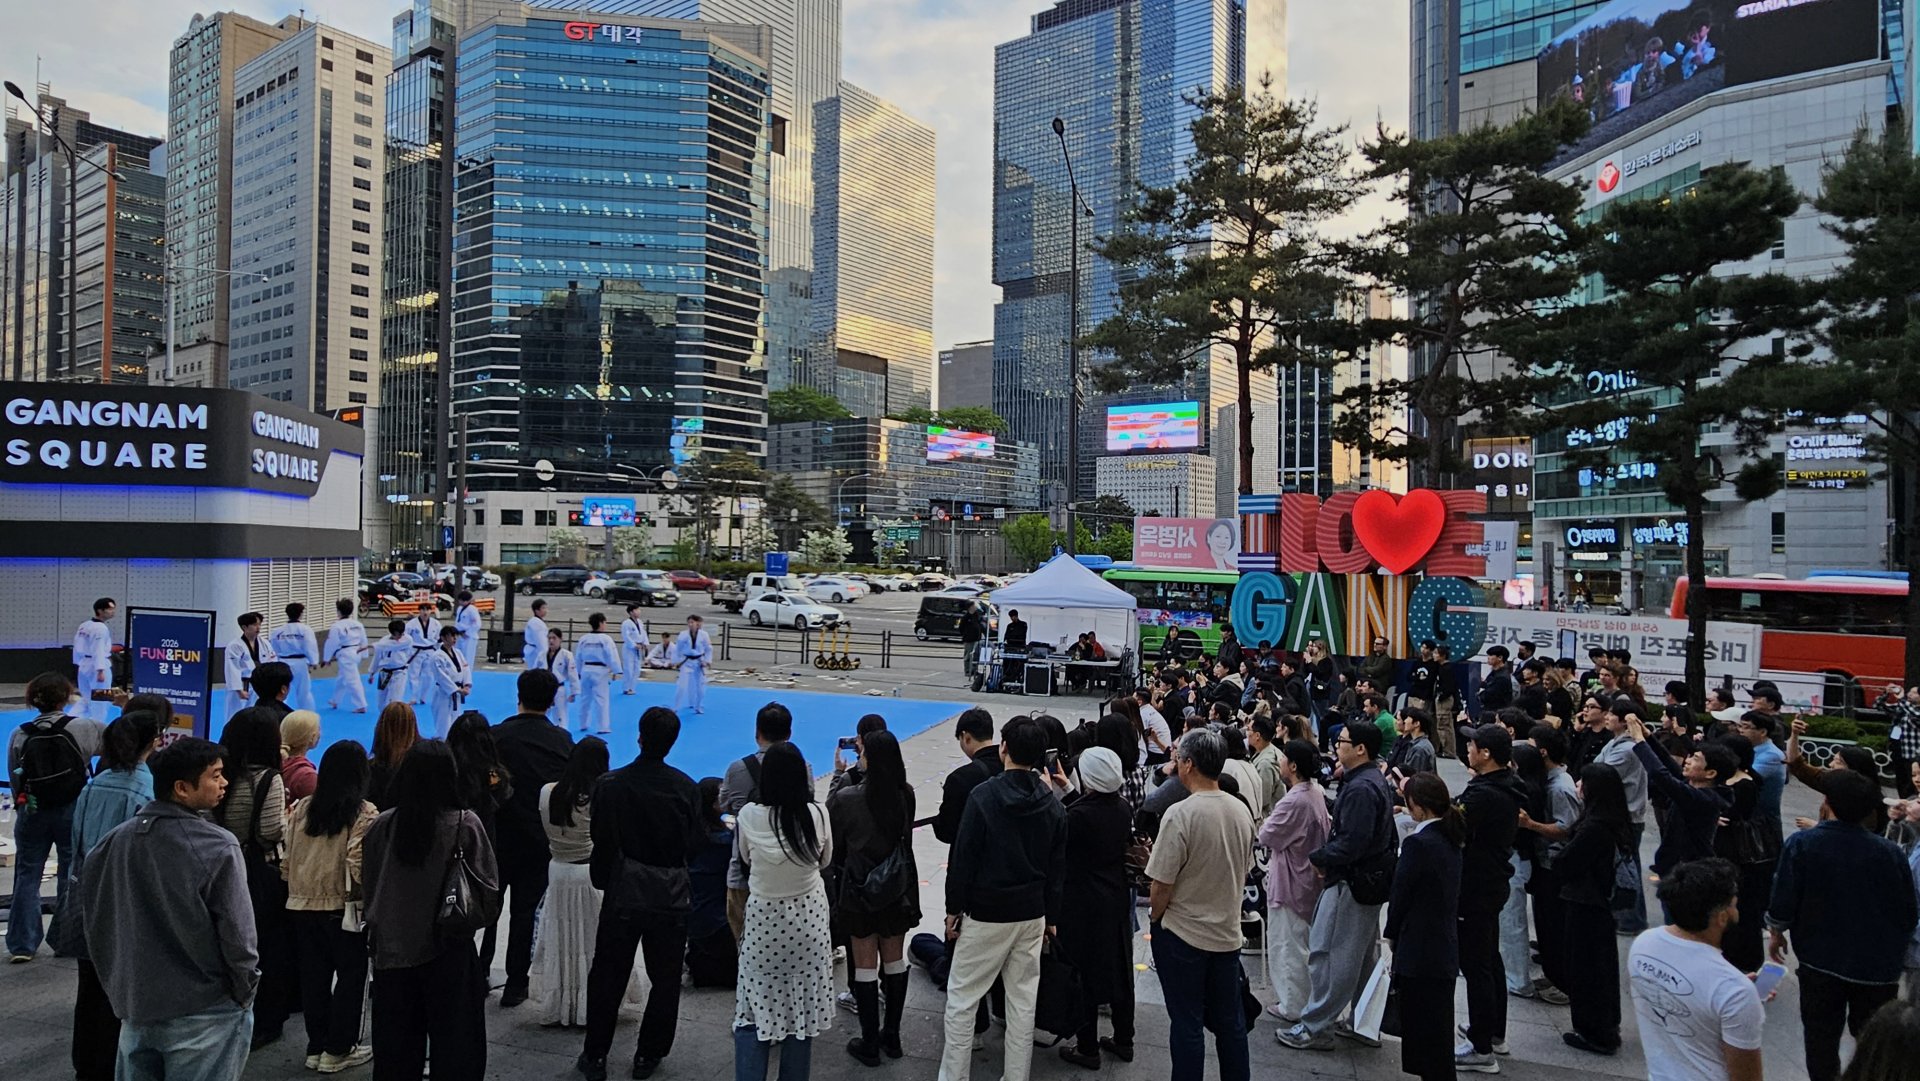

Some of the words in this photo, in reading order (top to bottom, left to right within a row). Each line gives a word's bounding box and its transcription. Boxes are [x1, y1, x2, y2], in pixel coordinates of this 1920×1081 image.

[1624, 131, 1701, 176] 한국몬테소리
[5, 398, 208, 430] GANGNAM
[252, 411, 320, 449] GANGNAM
[5, 439, 207, 470] SQUARE
[252, 448, 319, 483] SQUARE
[1474, 452, 1528, 469] DOR
[1231, 571, 1488, 662] GANG
[140, 647, 200, 662] FUN&FUN
[161, 639, 179, 648] 2026
